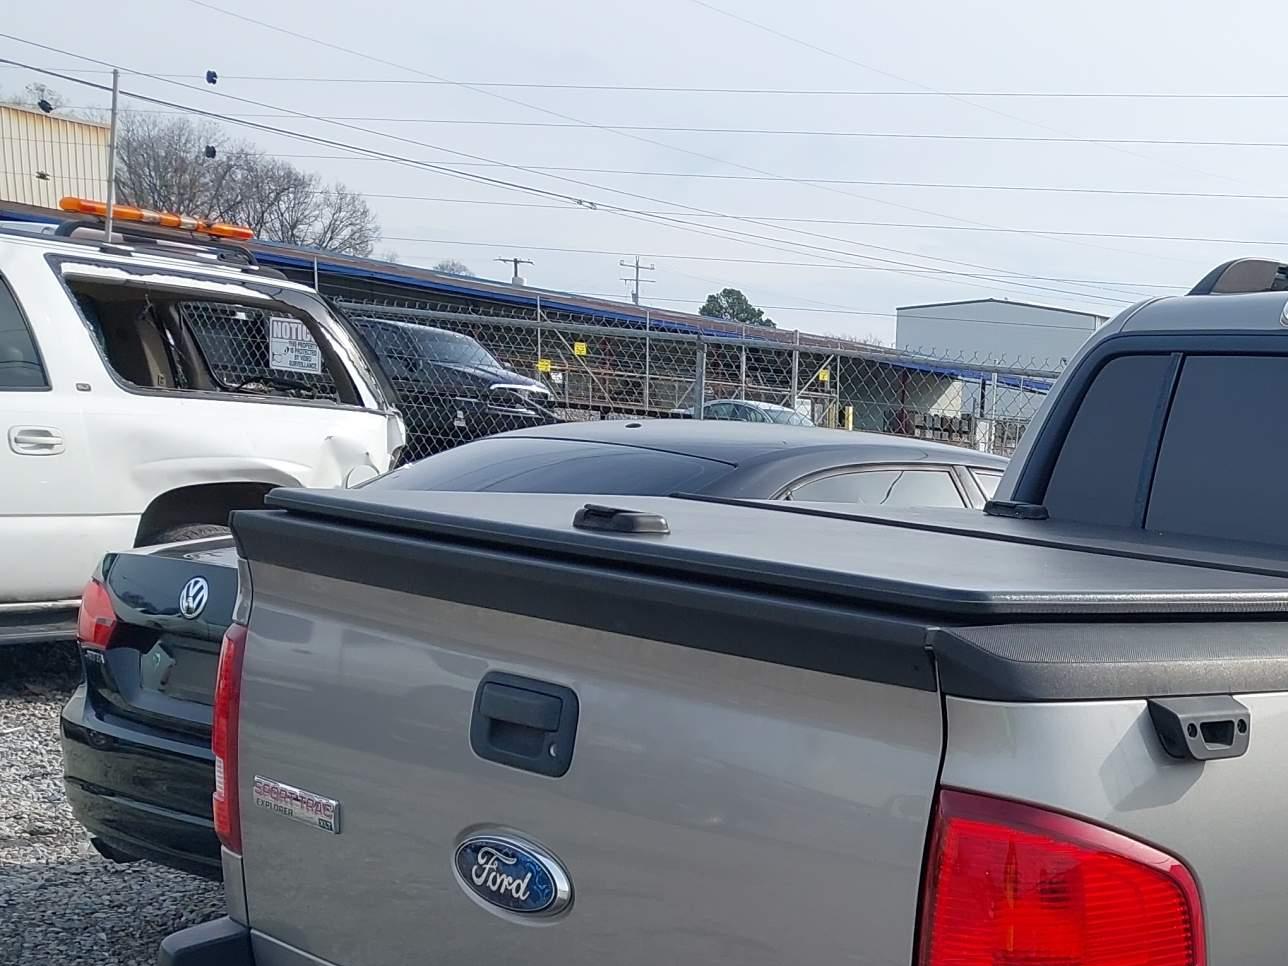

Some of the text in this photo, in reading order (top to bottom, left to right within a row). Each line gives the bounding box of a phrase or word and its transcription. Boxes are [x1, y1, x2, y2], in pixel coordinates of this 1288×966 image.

[272, 321, 312, 340] NOTIC
[256, 798, 293, 817] EXPLORER
[471, 847, 532, 900] Ford
